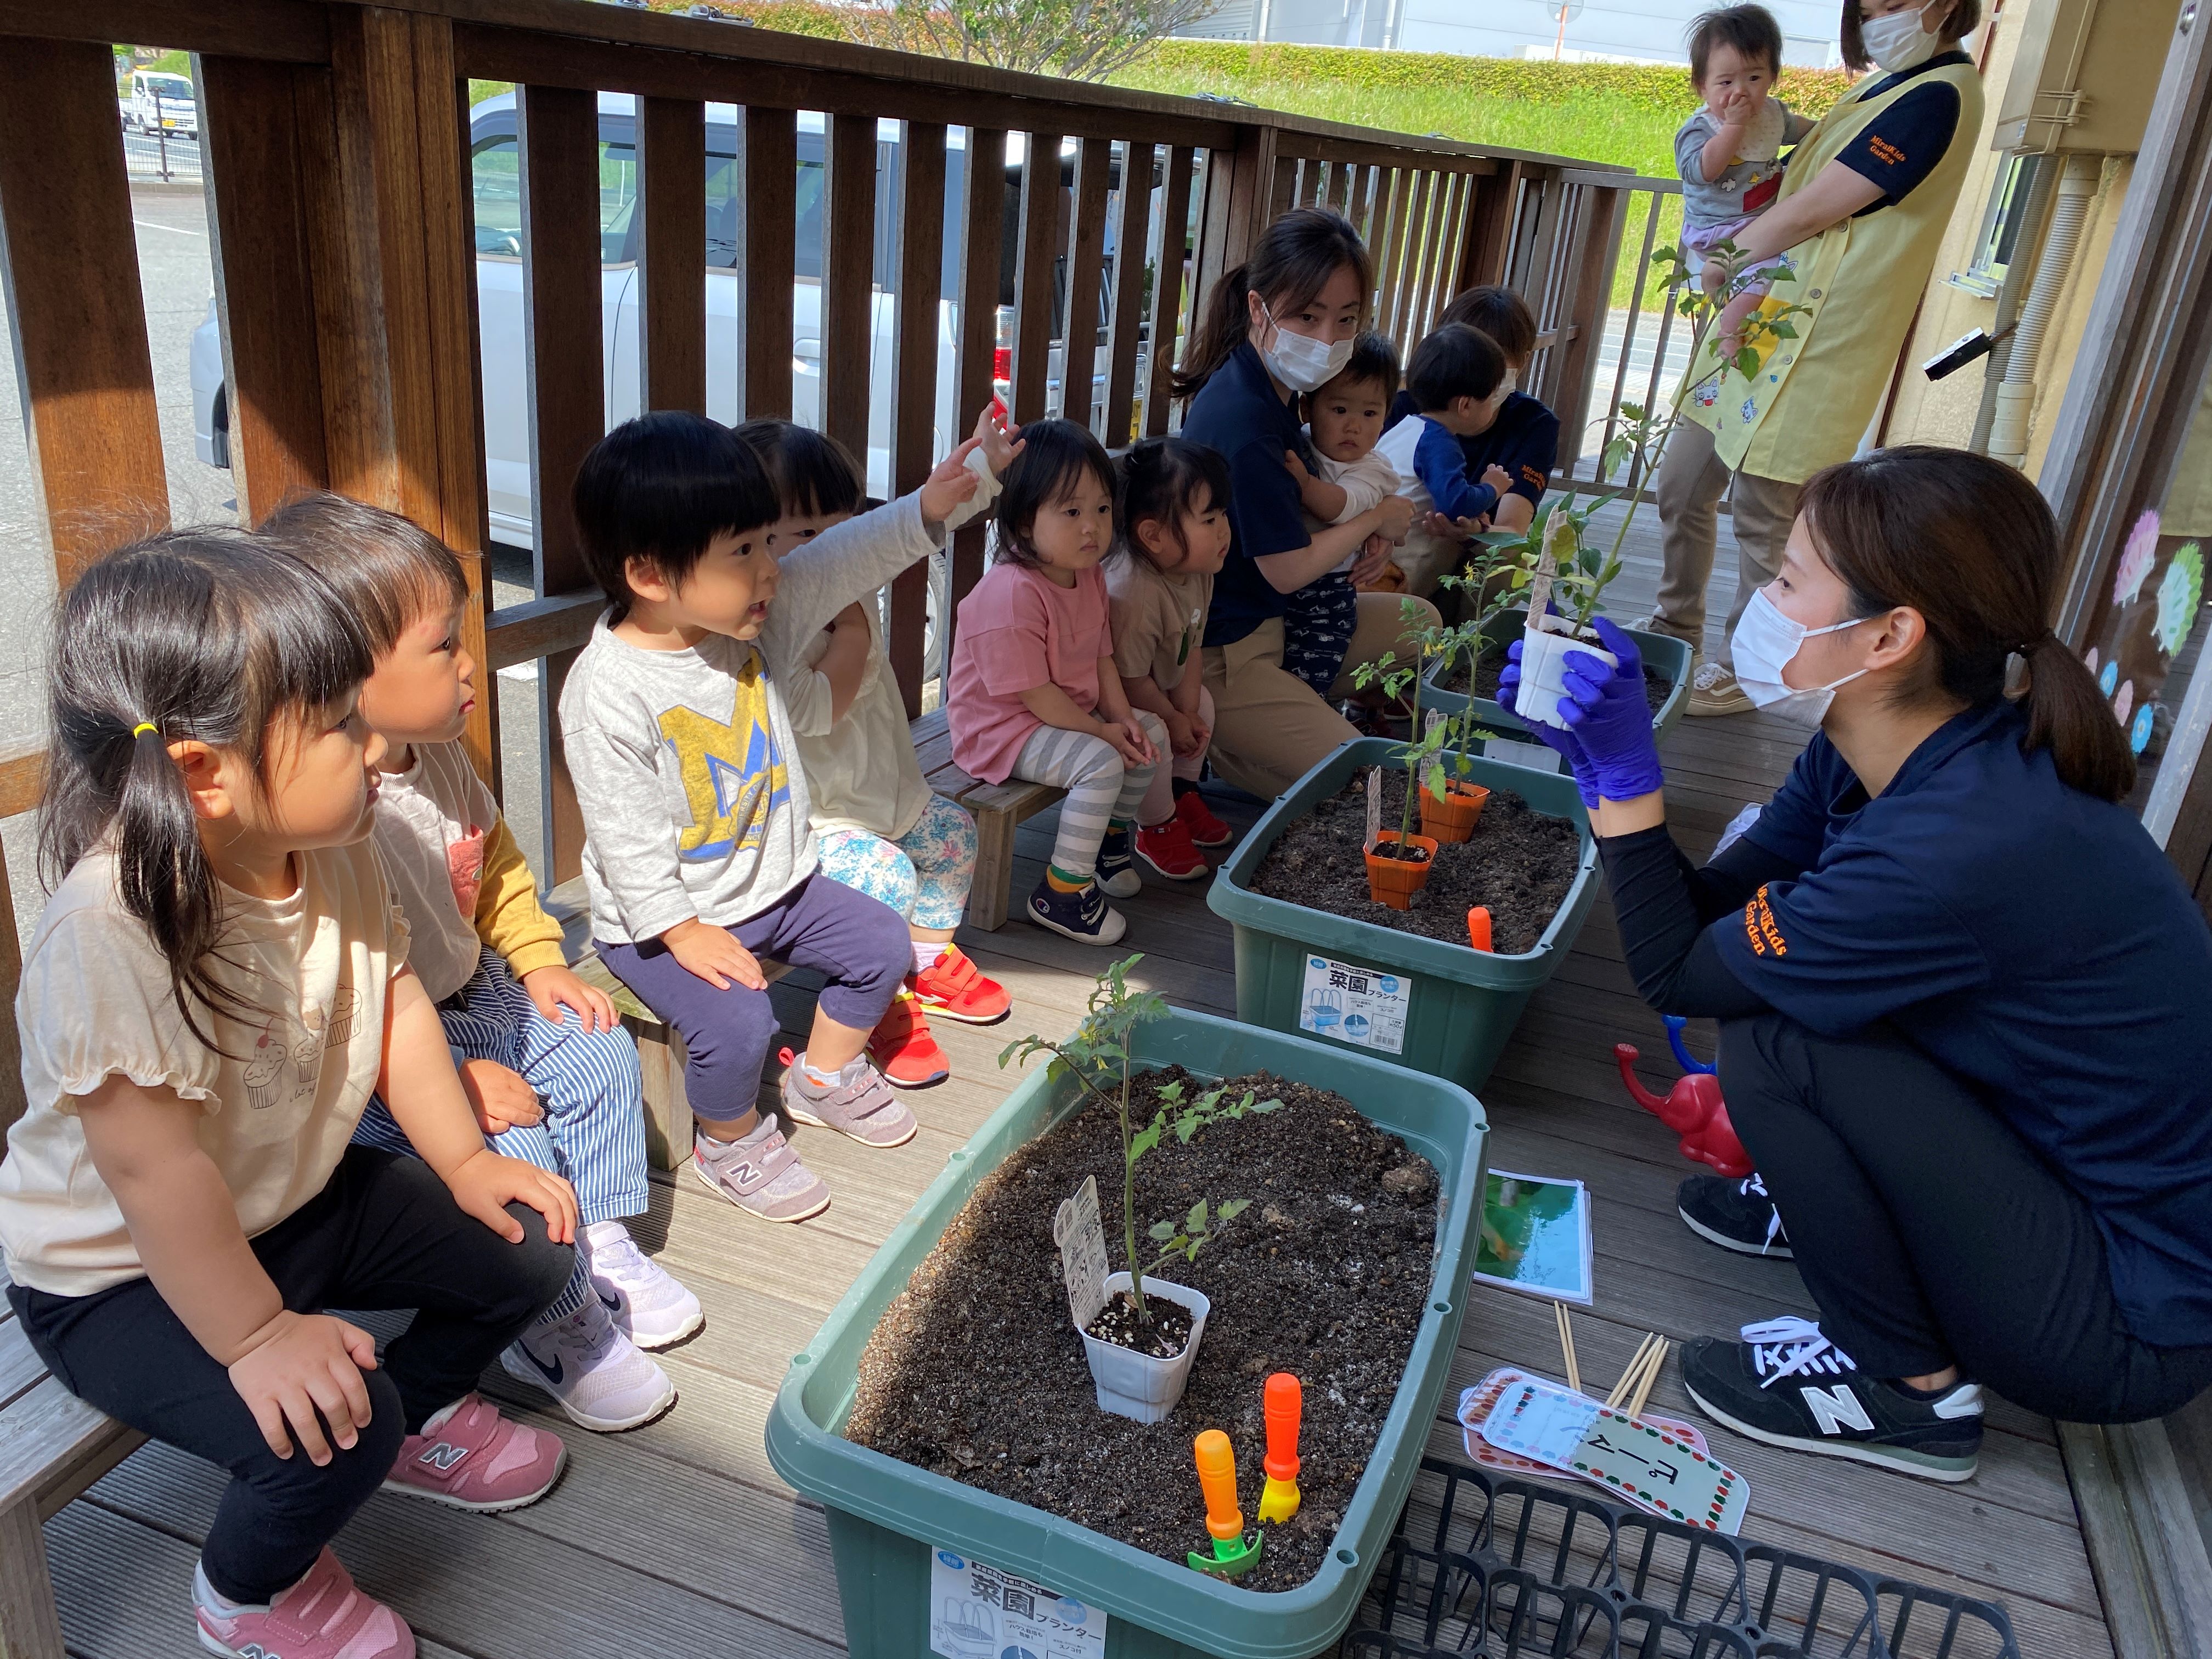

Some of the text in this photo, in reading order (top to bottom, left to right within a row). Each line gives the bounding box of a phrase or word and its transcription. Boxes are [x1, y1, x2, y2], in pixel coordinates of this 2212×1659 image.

[1870, 135, 1906, 162] MiraiKids
[1870, 145, 1895, 165] Garden
[1746, 900, 1765, 956] Garden
[726, 1161, 763, 1187] N
[1799, 1384, 1875, 1434] N
[418, 1443, 469, 1470] N
